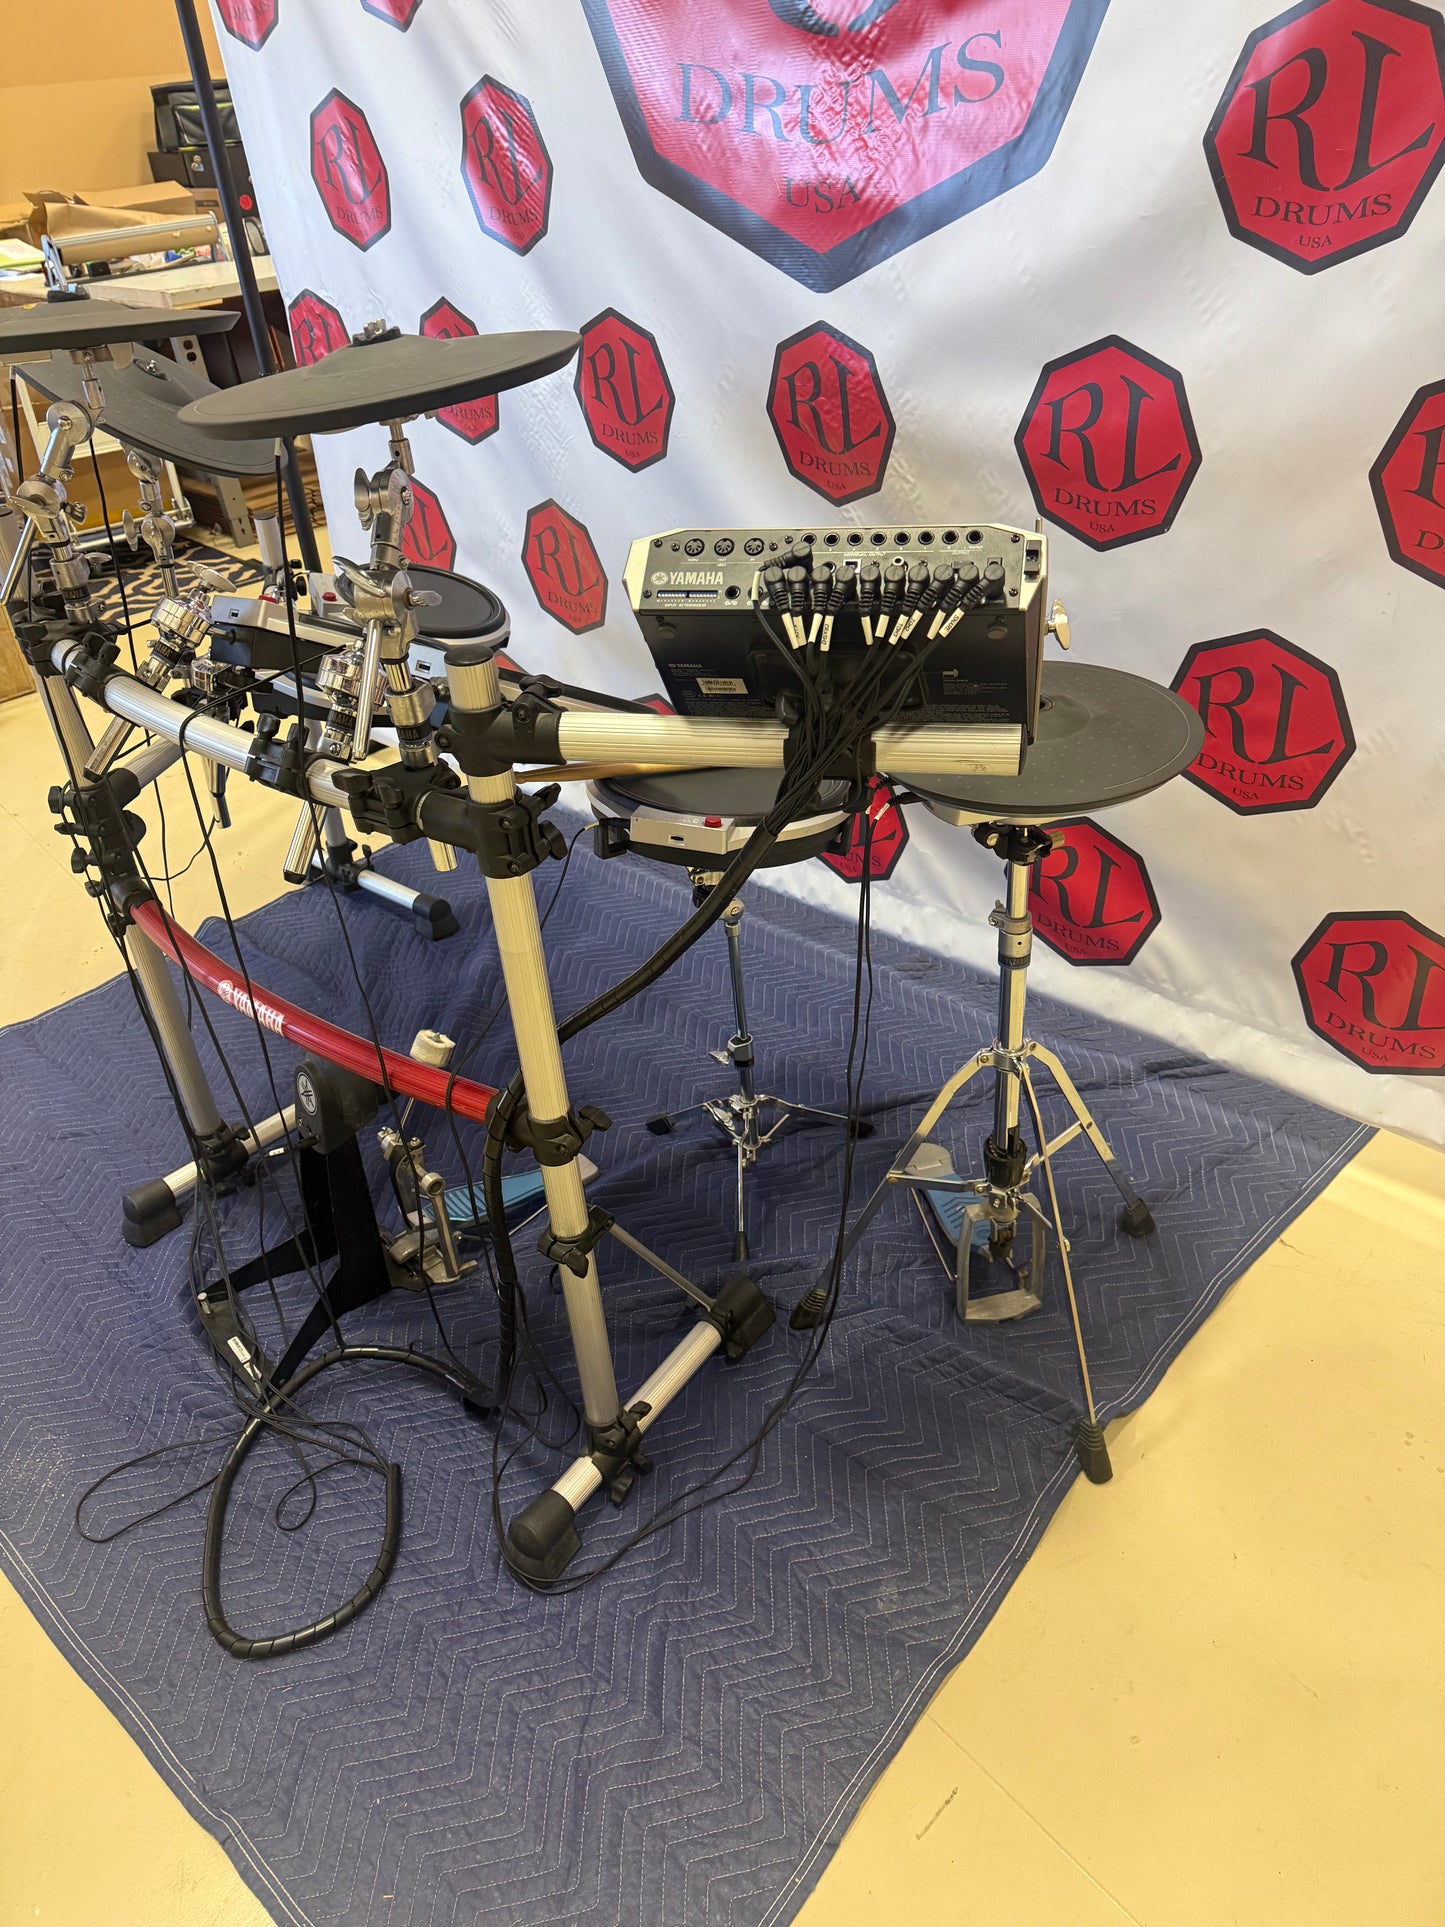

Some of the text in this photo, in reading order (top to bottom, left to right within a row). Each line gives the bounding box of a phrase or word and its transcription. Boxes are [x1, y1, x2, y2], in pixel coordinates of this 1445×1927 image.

[674, 30, 1004, 145] DRUMS
[1237, 30, 1435, 192] RL
[316, 117, 382, 204] RL
[469, 111, 542, 205] RL
[784, 175, 861, 214] USA
[1252, 193, 1392, 226] DRUMS
[336, 205, 383, 225] DRUMS
[489, 206, 539, 226] DRUMS
[1299, 234, 1332, 248] USA
[586, 337, 664, 426] RL
[781, 355, 882, 455] RL
[602, 423, 658, 445] DRUMS
[1040, 374, 1182, 492] RL
[800, 451, 872, 476] DRUMS
[827, 480, 846, 491] USA
[1054, 488, 1156, 516] DRUMS
[1089, 522, 1115, 533] USA
[533, 523, 600, 597] RL
[669, 572, 724, 585] YAMAHA
[548, 591, 598, 613] DRUMS
[944, 614, 960, 632] SNARE
[1192, 663, 1334, 765] RL
[1197, 752, 1304, 791] DRUMS
[1232, 787, 1258, 800] USA
[1029, 845, 1144, 928] RL
[1037, 913, 1120, 951] DRUMS
[1325, 1011, 1436, 1060] DRUMS
[1361, 1047, 1389, 1062] USA
